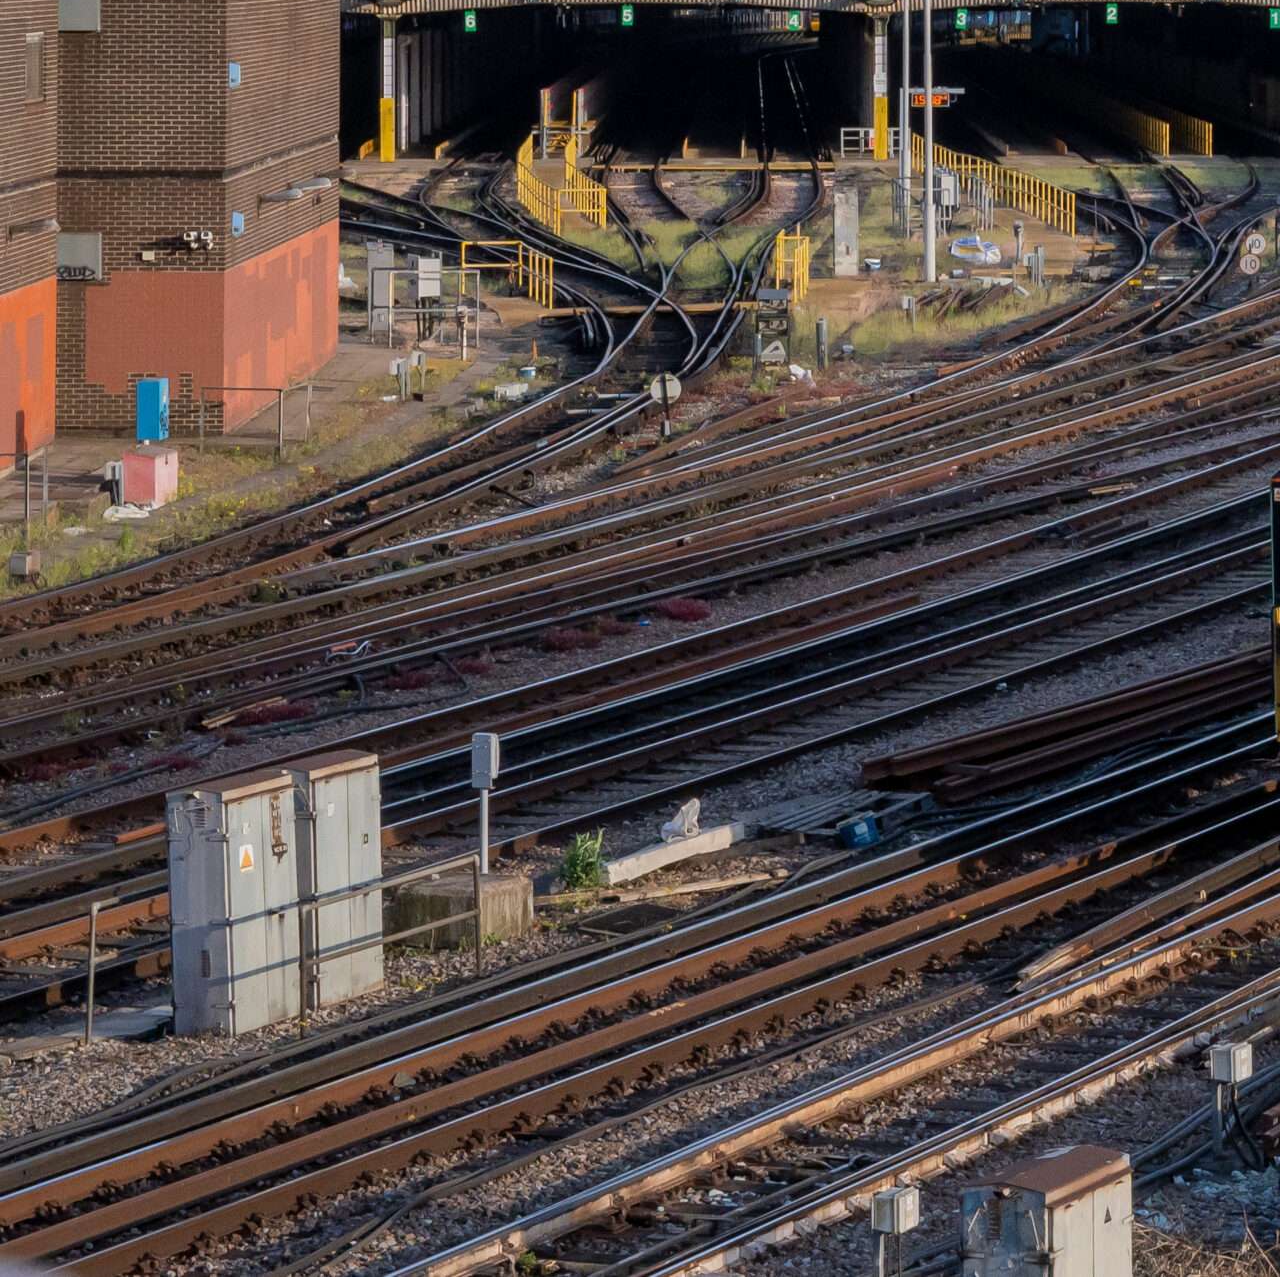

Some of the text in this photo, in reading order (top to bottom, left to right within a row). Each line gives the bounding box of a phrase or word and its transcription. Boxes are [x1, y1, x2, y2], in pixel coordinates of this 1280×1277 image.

[622, 9, 633, 22] 5
[956, 12, 966, 25] 3
[1107, 7, 1117, 20] 2
[1271, 12, 1279, 24] 1
[465, 14, 476, 28] 6
[788, 14, 799, 27] 4
[1251, 239, 1261, 249] 10
[1244, 259, 1257, 269] 10
